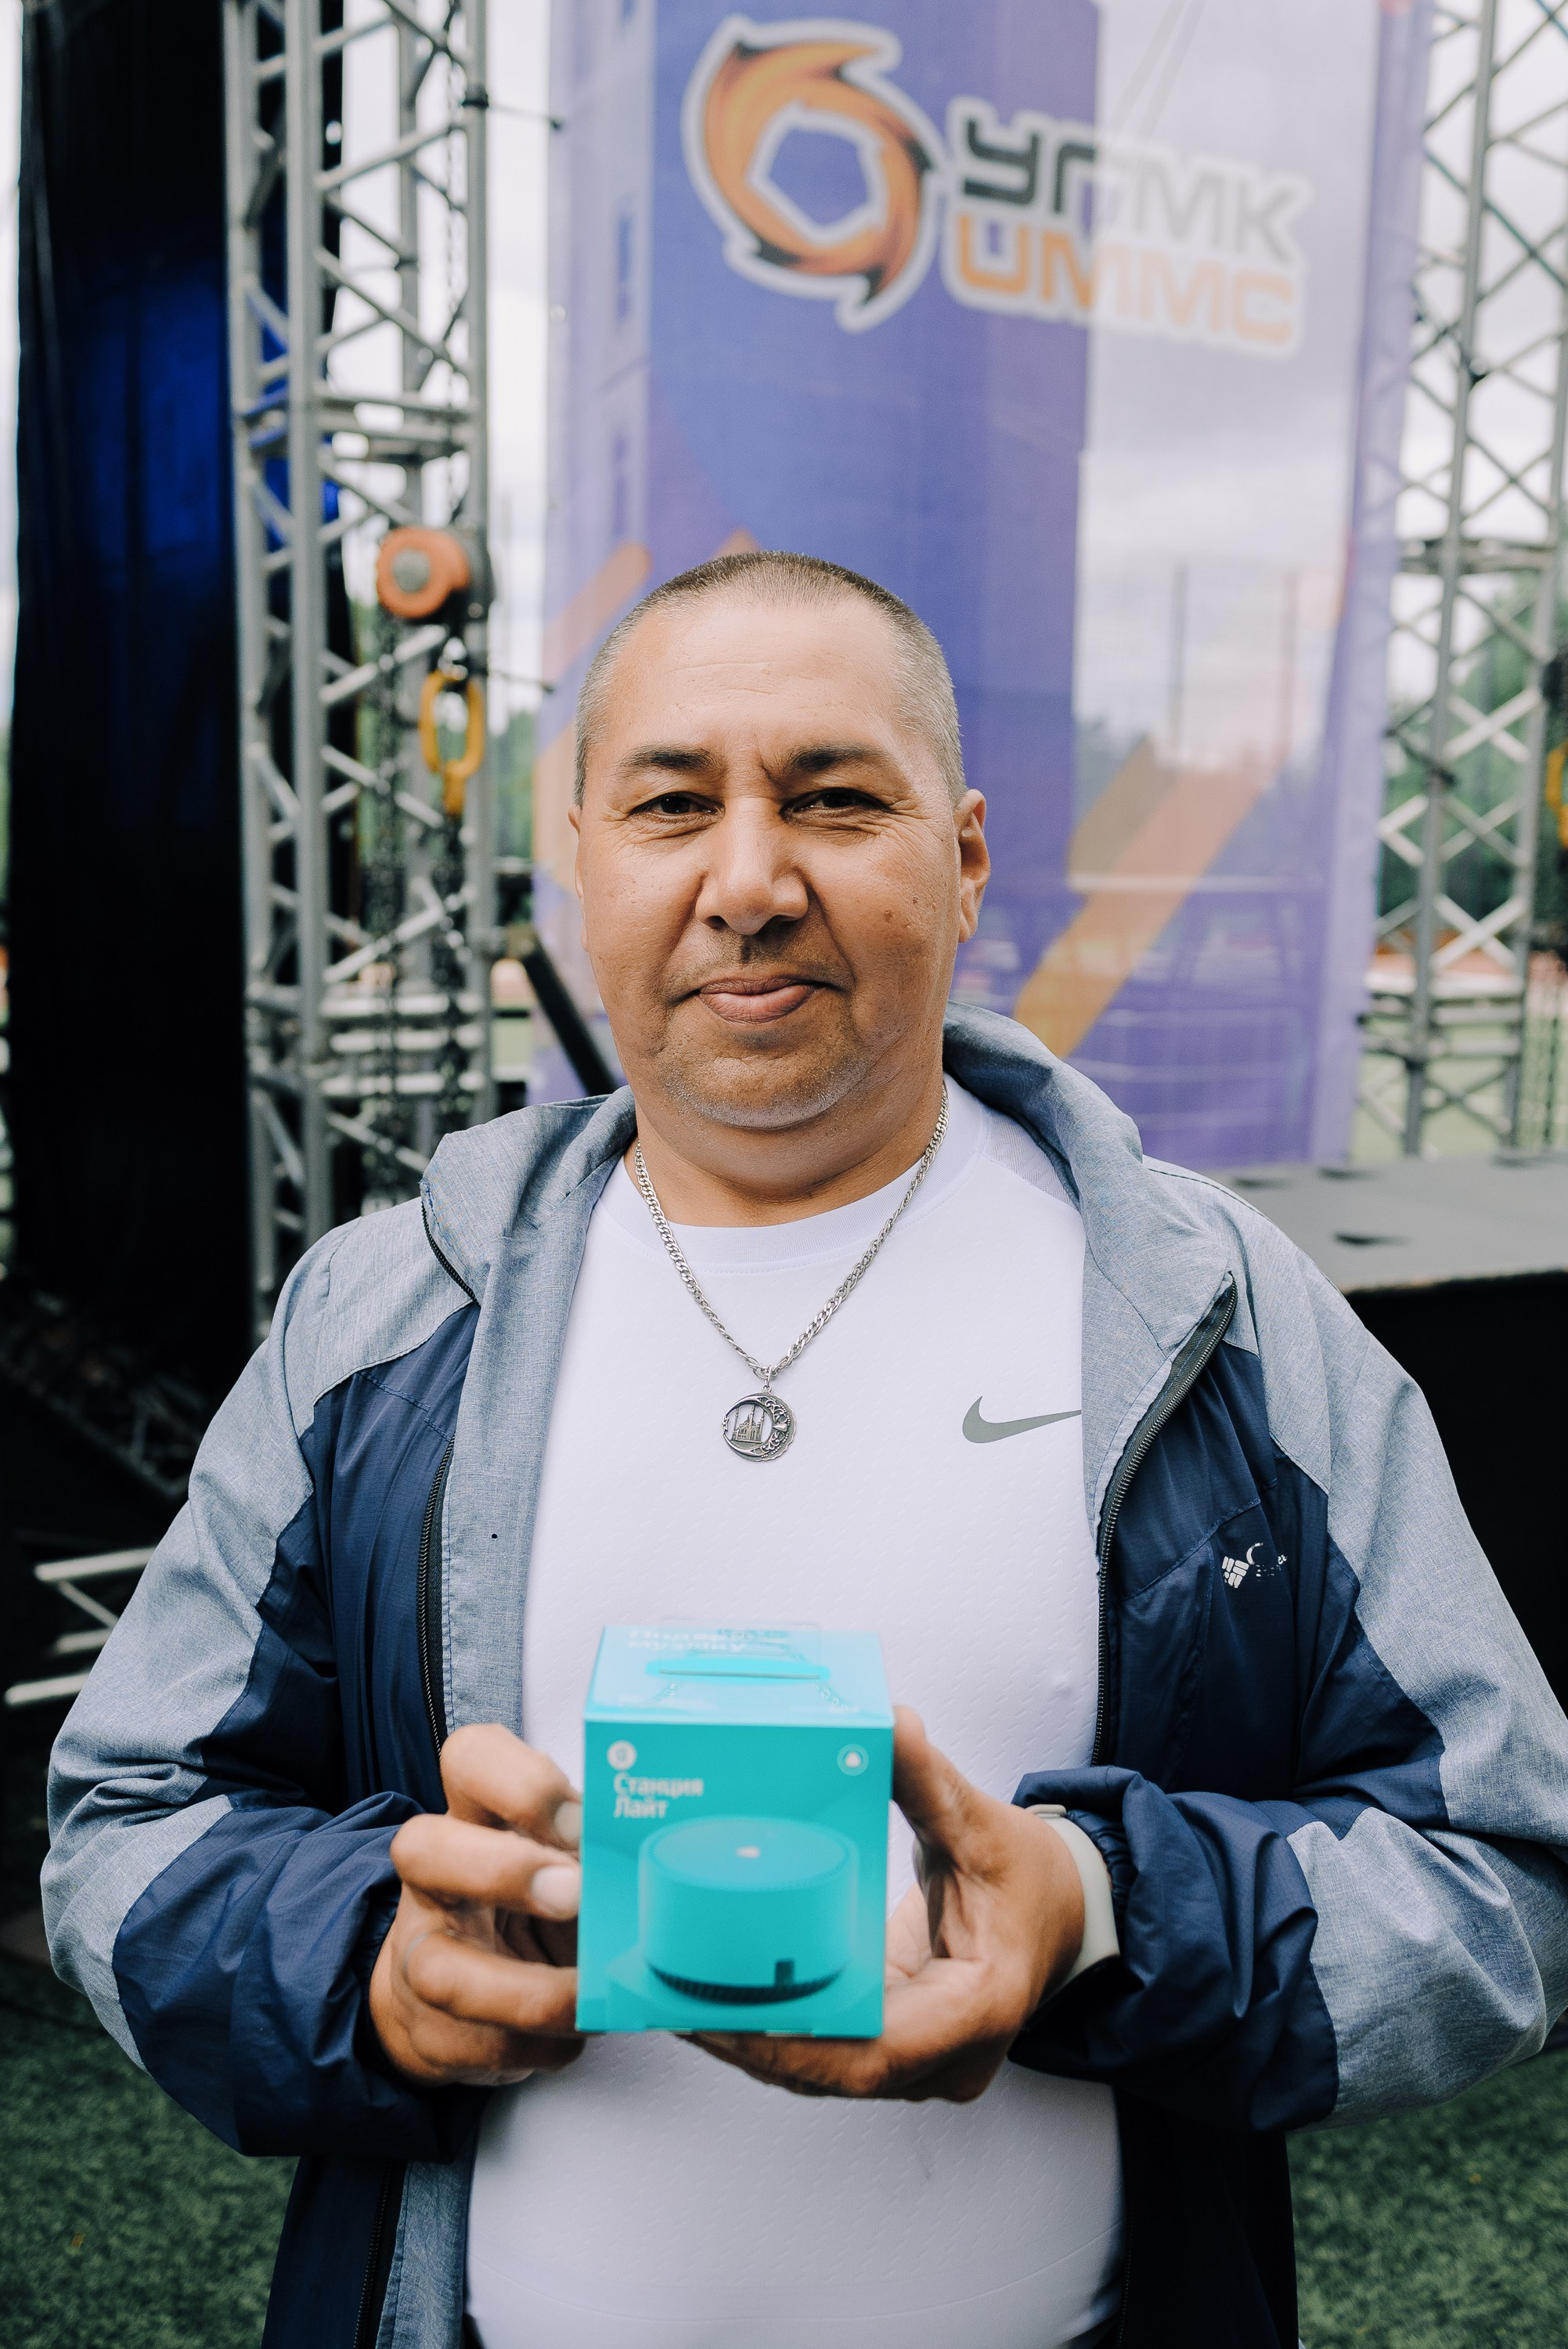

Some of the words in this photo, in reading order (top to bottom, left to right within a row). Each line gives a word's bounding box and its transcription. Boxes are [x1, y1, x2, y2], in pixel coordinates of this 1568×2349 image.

[962, 117, 1294, 265] УГМК
[957, 213, 1296, 346] UMMC
[614, 1771, 704, 1799] Станция
[614, 1795, 669, 1818] Лайт
